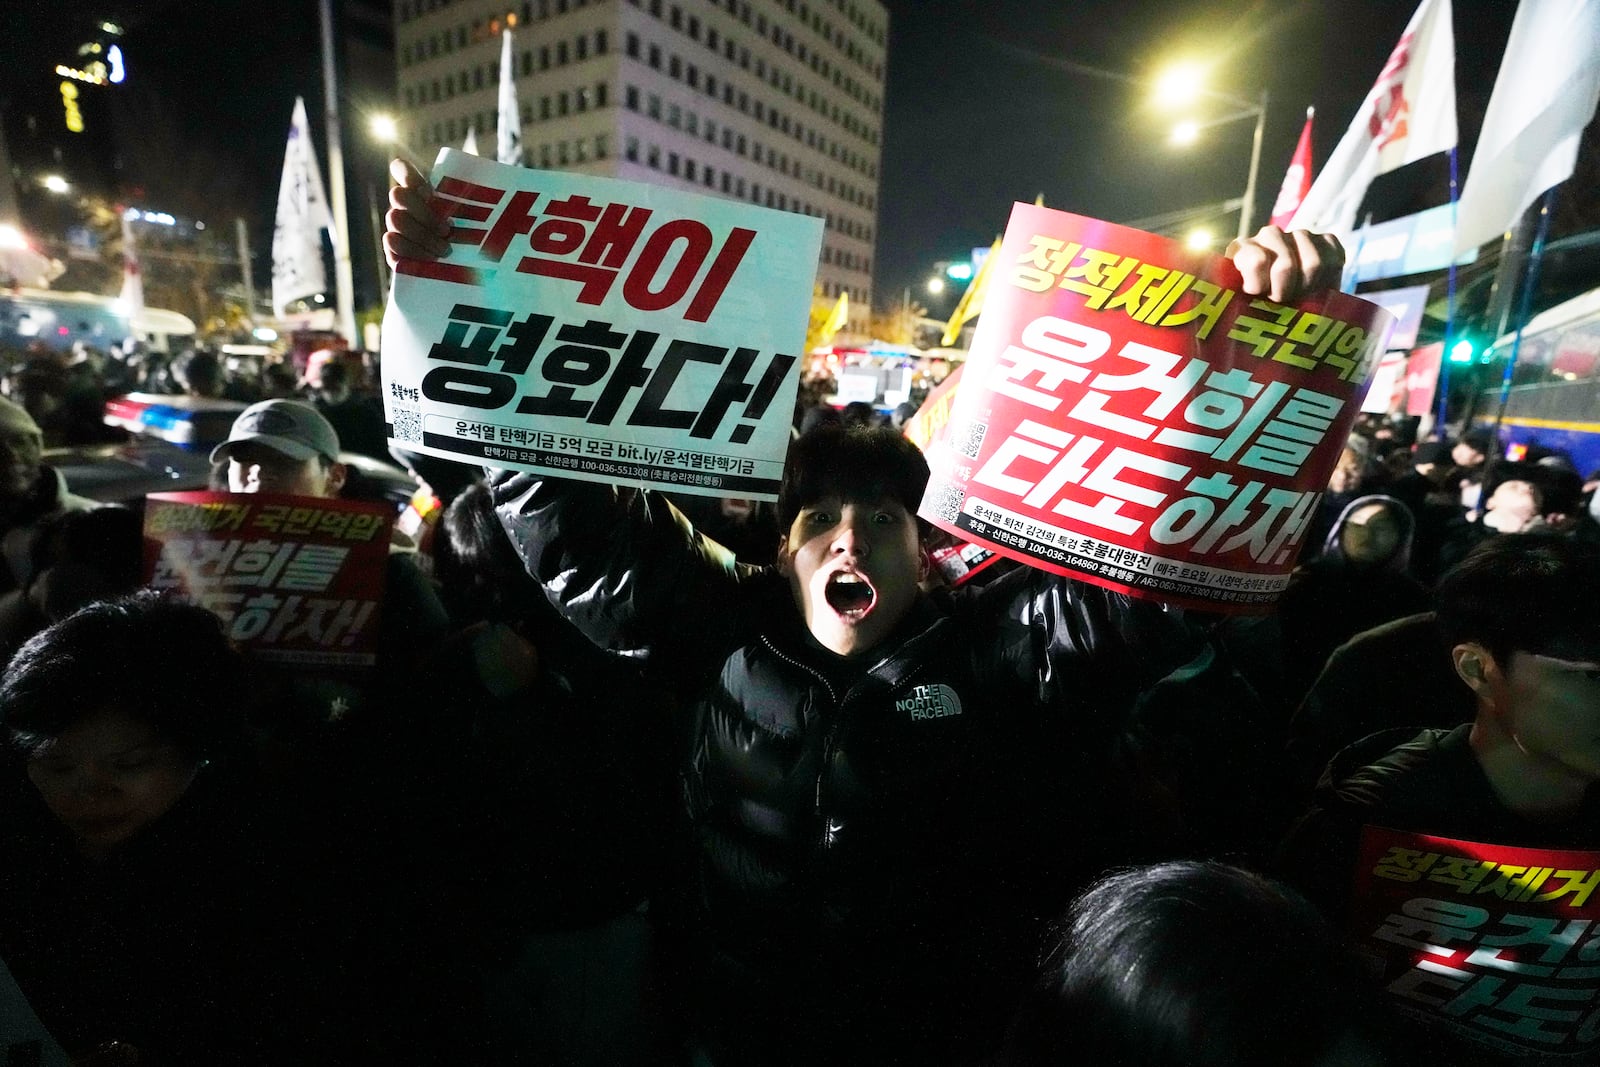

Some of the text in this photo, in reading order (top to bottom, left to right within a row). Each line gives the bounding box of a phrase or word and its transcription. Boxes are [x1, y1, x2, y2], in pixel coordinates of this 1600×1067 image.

[395, 176, 756, 322] 탄핵이
[1007, 234, 1235, 340] 정적제거
[421, 304, 796, 444] 평화다!
[984, 315, 1345, 476] 윤건희를
[456, 421, 755, 475] 윤석열 탄핵기금 5억 모금 bit.ly/윤석열탄핵기금
[484, 446, 518, 460] 탄핵기금
[519, 451, 537, 463] 모금
[544, 456, 579, 469] 신한은행
[580, 459, 649, 477] 100-036-551308
[253, 504, 384, 542] 국민억압
[973, 418, 1322, 565] 타도하자!
[968, 519, 986, 533] 후원
[992, 529, 1026, 549] 신한은행
[1027, 542, 1098, 571] 100-036-164860
[1099, 565, 1135, 582] 촛불행동
[1142, 576, 1159, 588] ARS
[973, 504, 1003, 524] 윤석열
[1004, 517, 1025, 532] 퇴진
[1026, 524, 1056, 543] 김건희
[1057, 535, 1078, 550] 특검
[1079, 538, 1152, 570] 촛불대행진
[1152, 561, 1178, 578] (매주
[1178, 566, 1210, 583] 토요일
[895, 695, 942, 712] NORTH
[910, 706, 944, 721] FACE
[913, 684, 939, 698] THE
[1373, 847, 1600, 907] 정적제거
[1372, 897, 1600, 979] 윤건
[1386, 959, 1600, 1045] 타도
